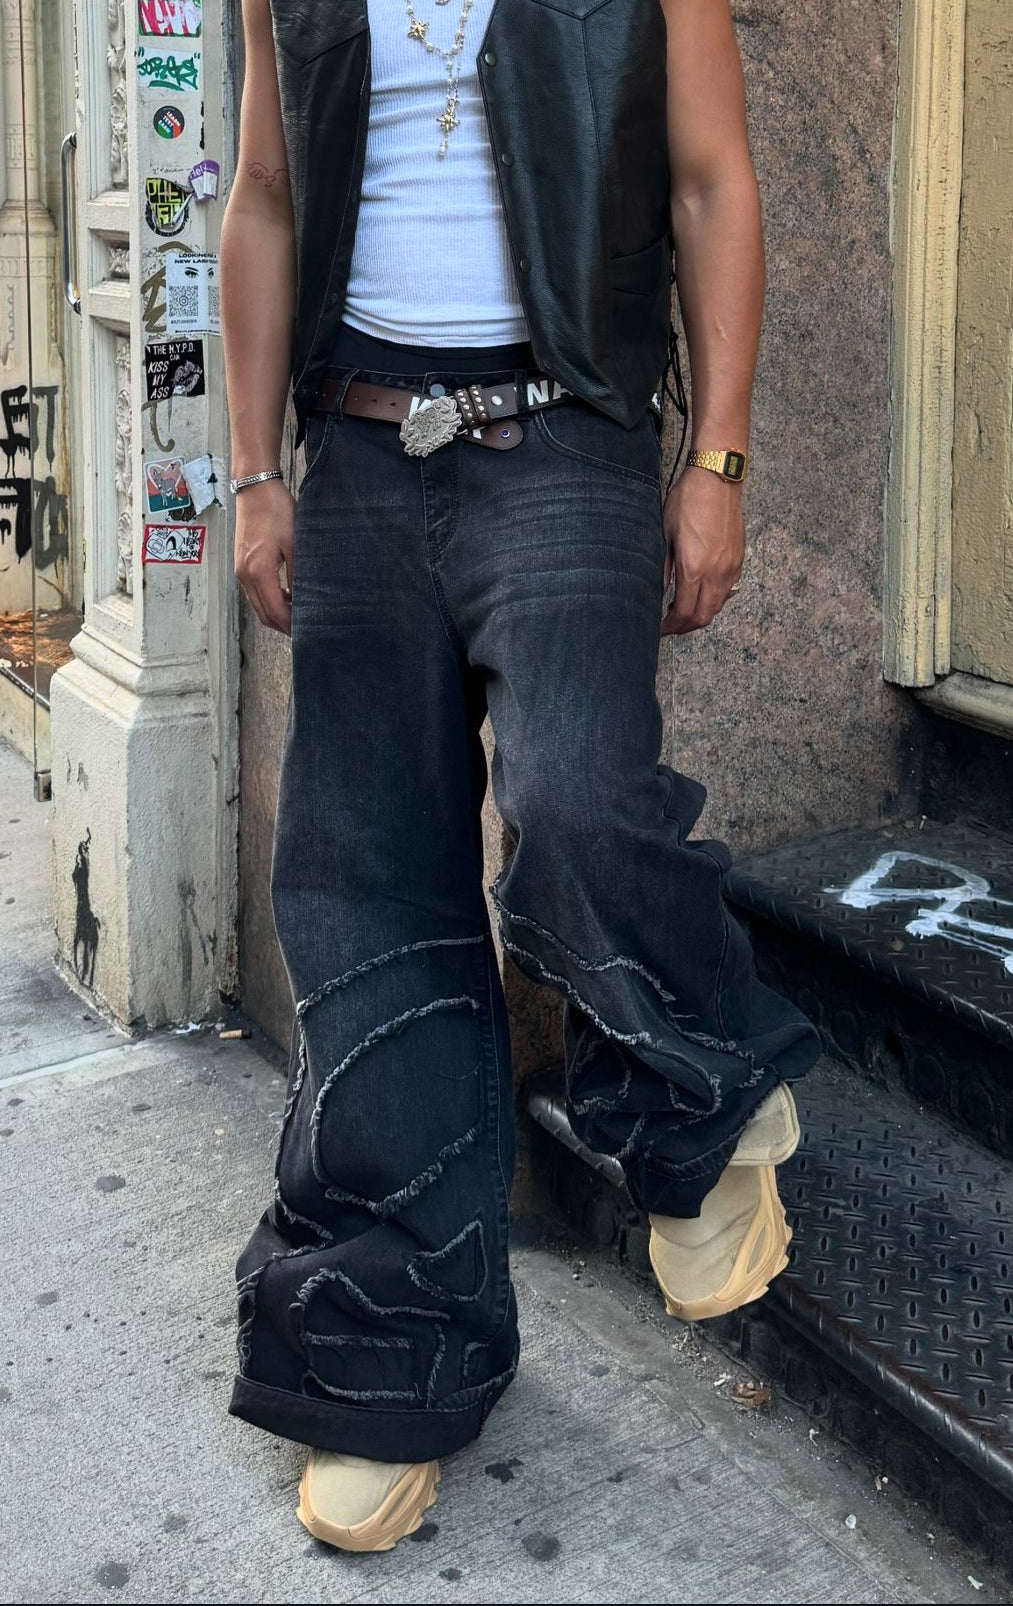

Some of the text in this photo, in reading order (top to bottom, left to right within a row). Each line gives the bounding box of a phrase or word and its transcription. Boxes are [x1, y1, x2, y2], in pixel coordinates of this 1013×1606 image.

[153, 345, 167, 355] THE
[148, 361, 170, 373] KISS
[152, 374, 167, 386] MY
[150, 386, 170, 399] ASS
